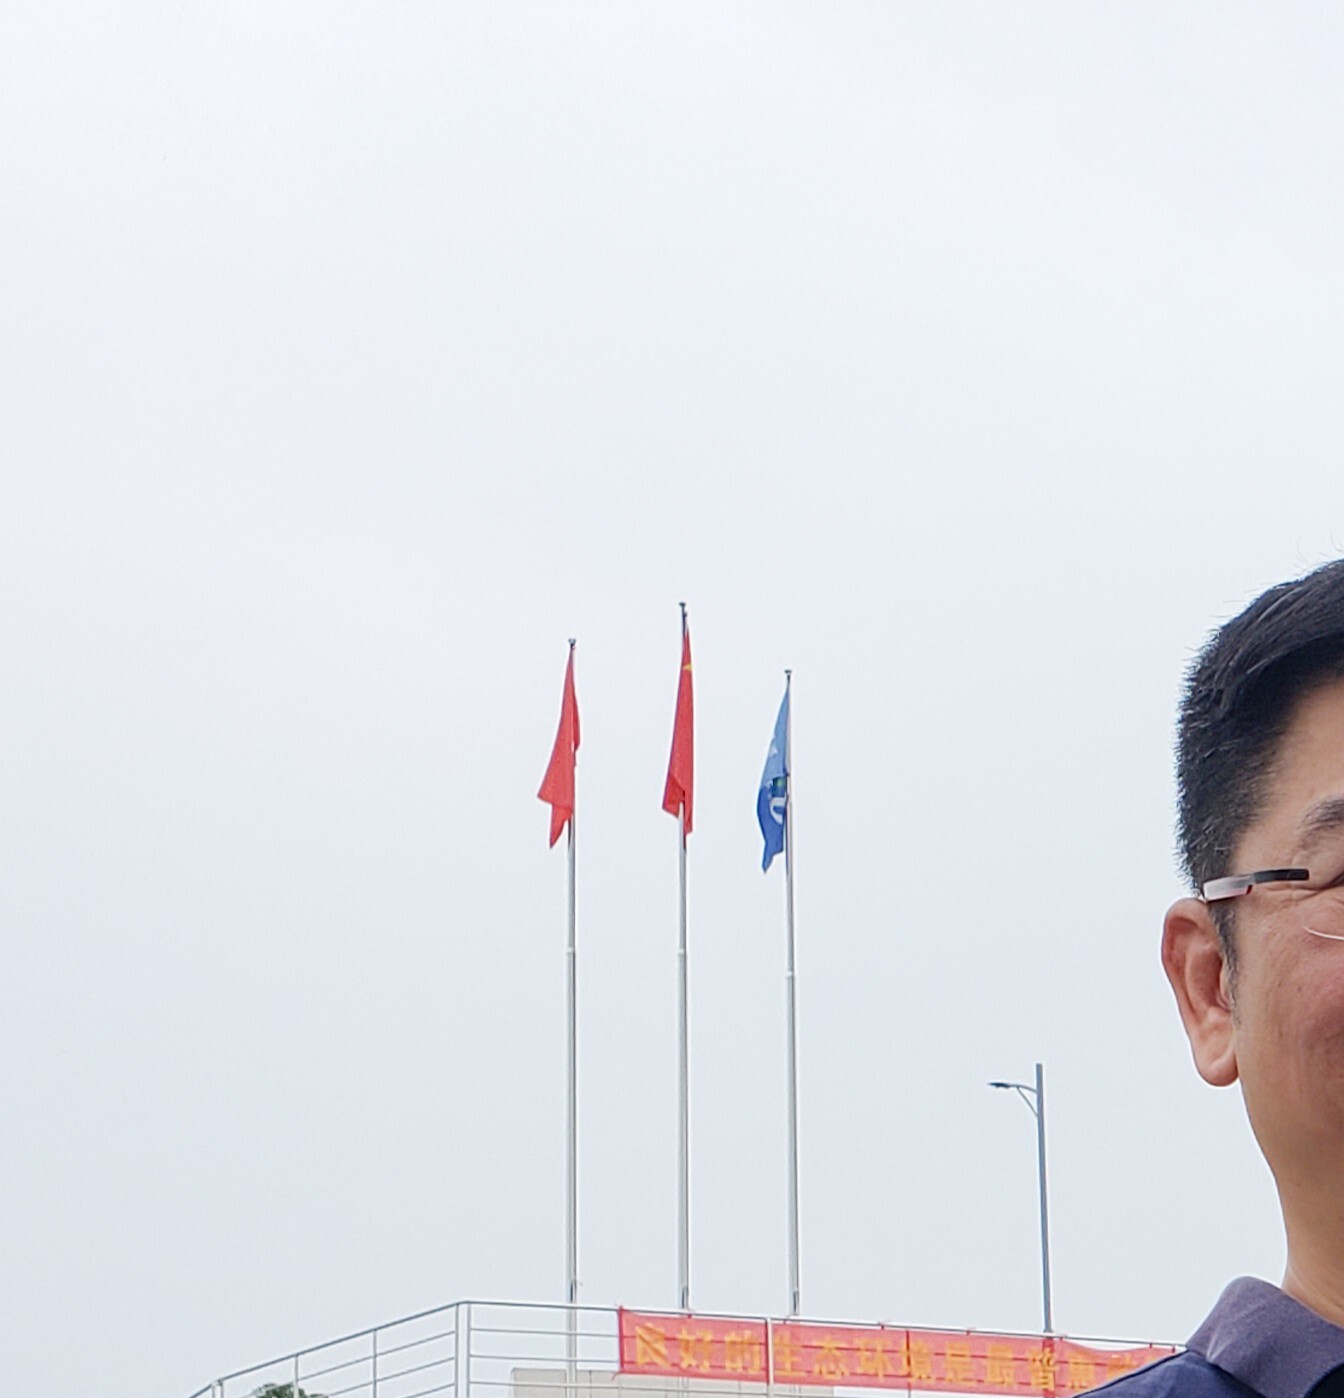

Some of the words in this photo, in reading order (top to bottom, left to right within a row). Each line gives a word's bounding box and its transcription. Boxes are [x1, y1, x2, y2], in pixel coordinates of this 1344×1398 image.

[635, 1322, 1160, 1392] 良好的生态环境是最普惠的
